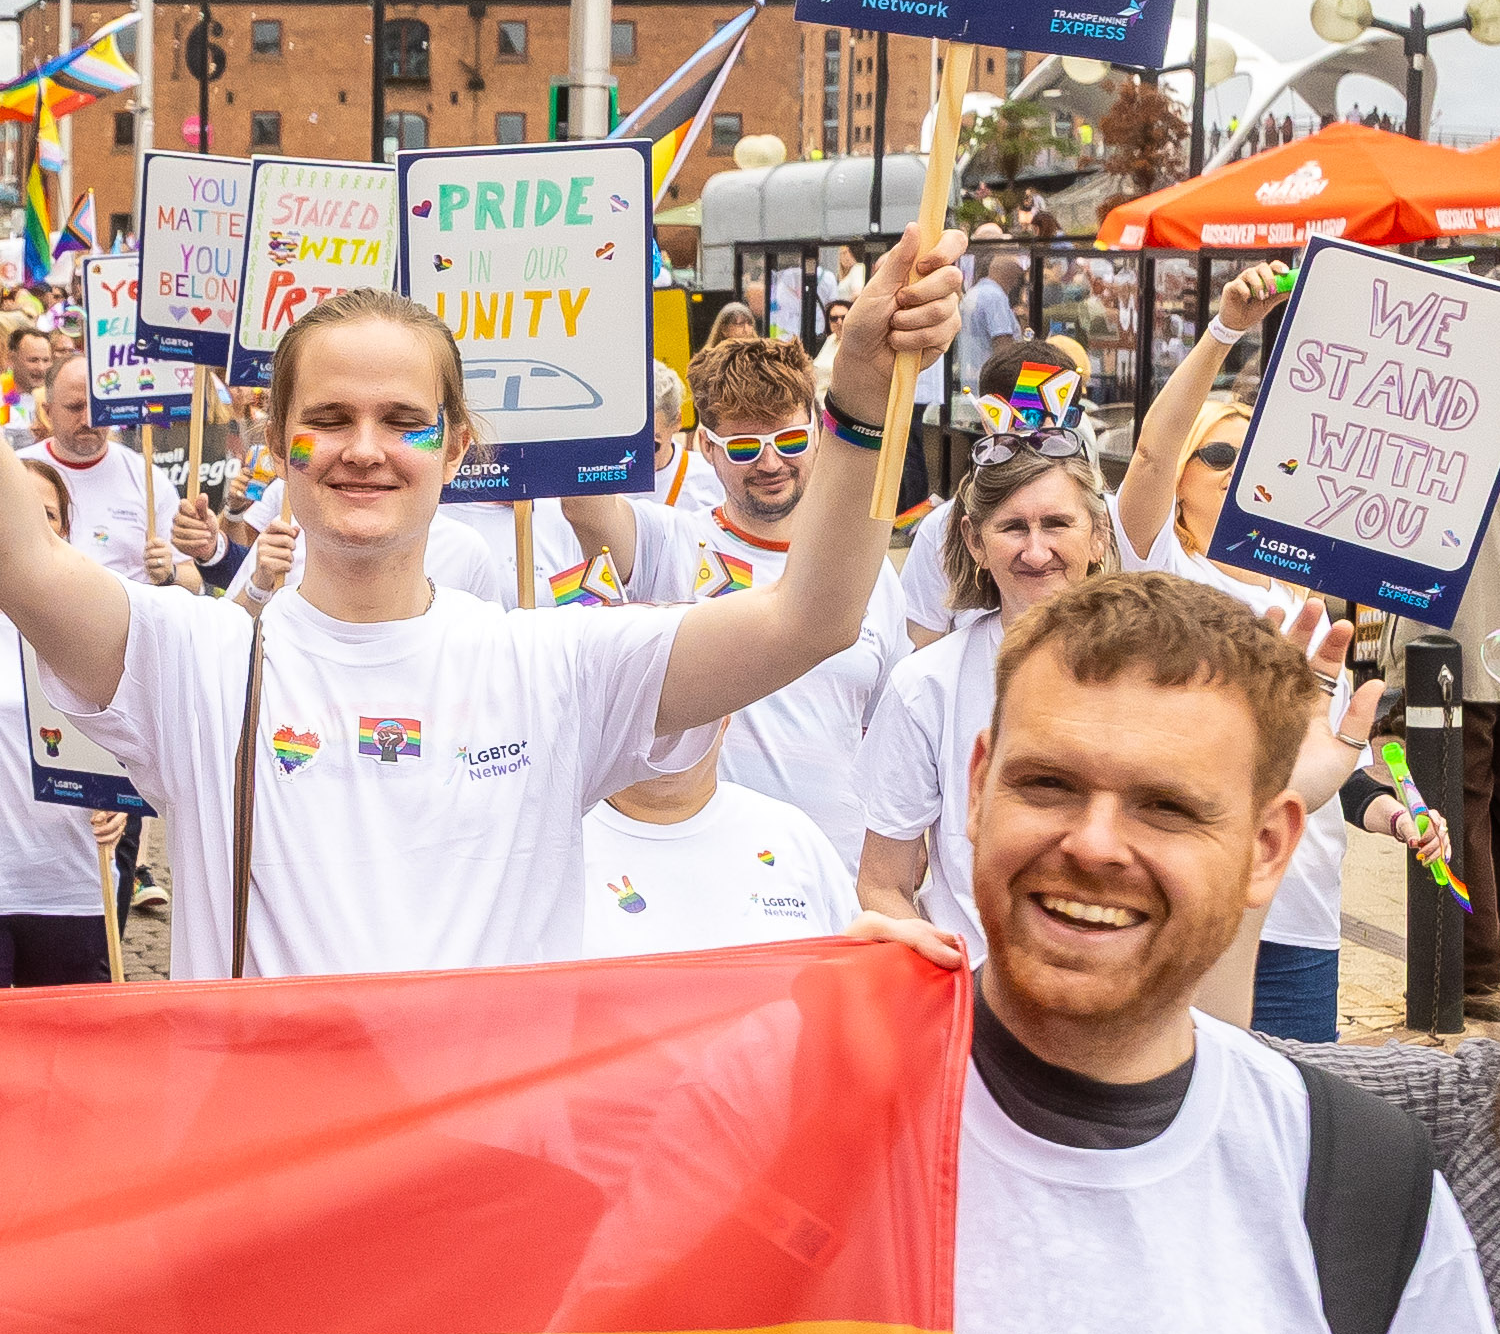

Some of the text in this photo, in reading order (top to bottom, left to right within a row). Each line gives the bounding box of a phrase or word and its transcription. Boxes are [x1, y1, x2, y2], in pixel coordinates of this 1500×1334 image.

[1049, 17, 1127, 42] EXPRESS
[1052, 8, 1128, 28] TRANSPENNINE
[188, 174, 238, 208] YOU
[438, 175, 596, 233] PRIDE
[156, 204, 246, 239] MATTE
[272, 192, 380, 231] STAFFED
[179, 243, 232, 278] YOU
[298, 235, 382, 266] WITH
[466, 243, 569, 284] IN OUR
[158, 270, 238, 304] BELON
[434, 286, 593, 343] UNITY
[1369, 278, 1469, 359] WE
[1289, 338, 1481, 432] STAND
[1306, 413, 1469, 505] WITH
[449, 475, 511, 490] Network
[576, 470, 628, 484] EXPRESS
[1304, 474, 1430, 550] YOU
[1252, 547, 1313, 576] Network
[1258, 534, 1318, 563] LGBTQ+
[1377, 586, 1431, 610] EXPRESS
[467, 739, 529, 767] LGBTQ+
[468, 753, 533, 782] Network
[761, 897, 807, 908] LGBTQ+
[763, 908, 808, 921] Network
